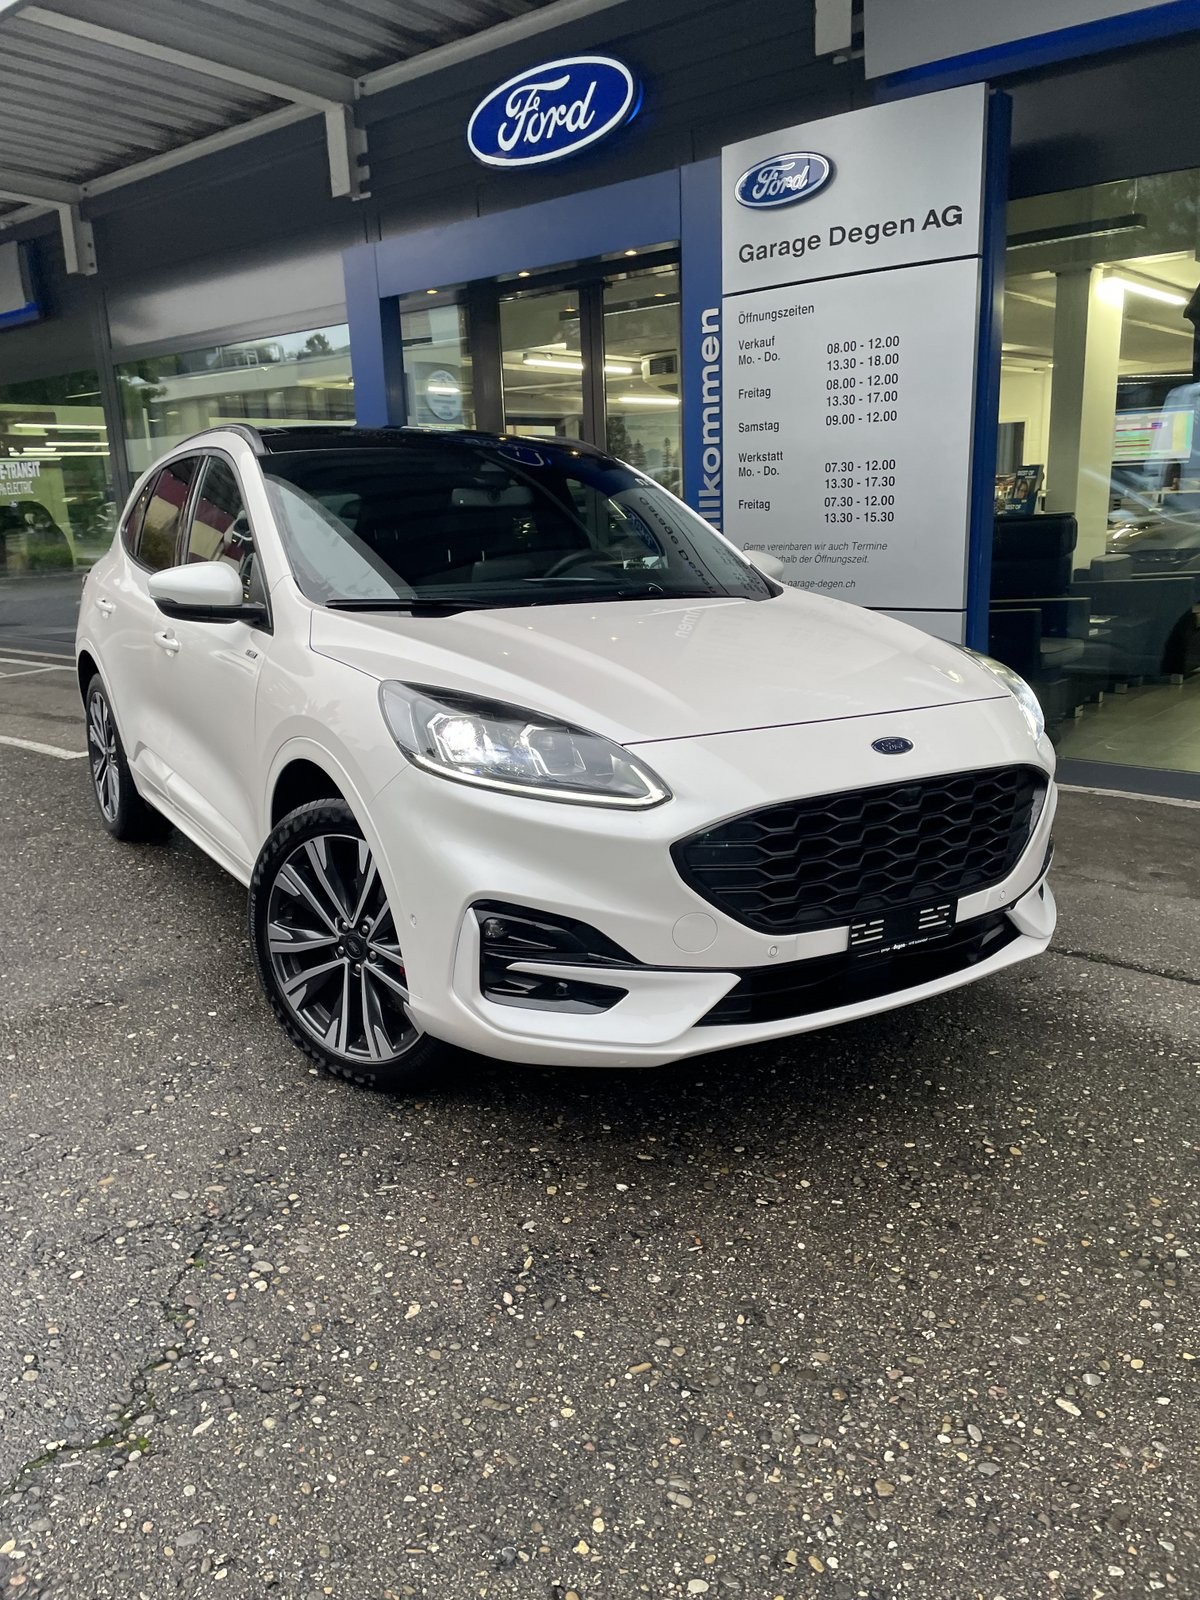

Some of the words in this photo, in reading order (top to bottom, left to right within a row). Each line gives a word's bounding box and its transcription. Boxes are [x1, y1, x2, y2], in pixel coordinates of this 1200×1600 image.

[497, 73, 597, 152] Ford
[752, 161, 810, 200] Ford
[738, 234, 822, 264] Garage
[829, 217, 915, 247] Degen
[920, 204, 963, 231] AG
[738, 303, 815, 325] Öffnungszeiten
[738, 335, 776, 351] Verkauf
[826, 340, 857, 355] 08.00
[868, 335, 900, 350] 12.00
[738, 354, 755, 366] Mo.
[764, 351, 781, 363] Do.
[826, 357, 857, 372] 13.30
[867, 352, 900, 367] 18.00
[826, 376, 857, 391] 08.00
[867, 372, 899, 387] 12.00
[738, 387, 772, 400] Freitag
[826, 393, 856, 408] 13.30
[866, 390, 898, 404] 17.00
[698, 307, 721, 530] llkommen
[825, 413, 856, 427] 09.00
[866, 409, 898, 424] 12.00
[738, 420, 780, 434] Samstag
[737, 450, 784, 463] Werkstatt
[738, 466, 755, 478] Mo.
[763, 465, 780, 476] Do.
[824, 461, 855, 474] 07.30
[865, 458, 896, 472] 12.00
[824, 477, 854, 489] 13.30
[864, 475, 896, 488] 17.30
[738, 498, 771, 512] Freitag
[824, 496, 854, 508] 07.30
[864, 494, 895, 507] 12.00
[824, 512, 853, 524] 13.30
[863, 511, 895, 523] 15.30
[743, 542, 766, 551] Gerne
[767, 541, 813, 551] vereinbaren
[814, 542, 827, 551] wir
[828, 541, 849, 551] auch
[852, 541, 888, 551] Termine
[799, 554, 813, 564] der
[814, 552, 869, 566] Öffnungszeit.
